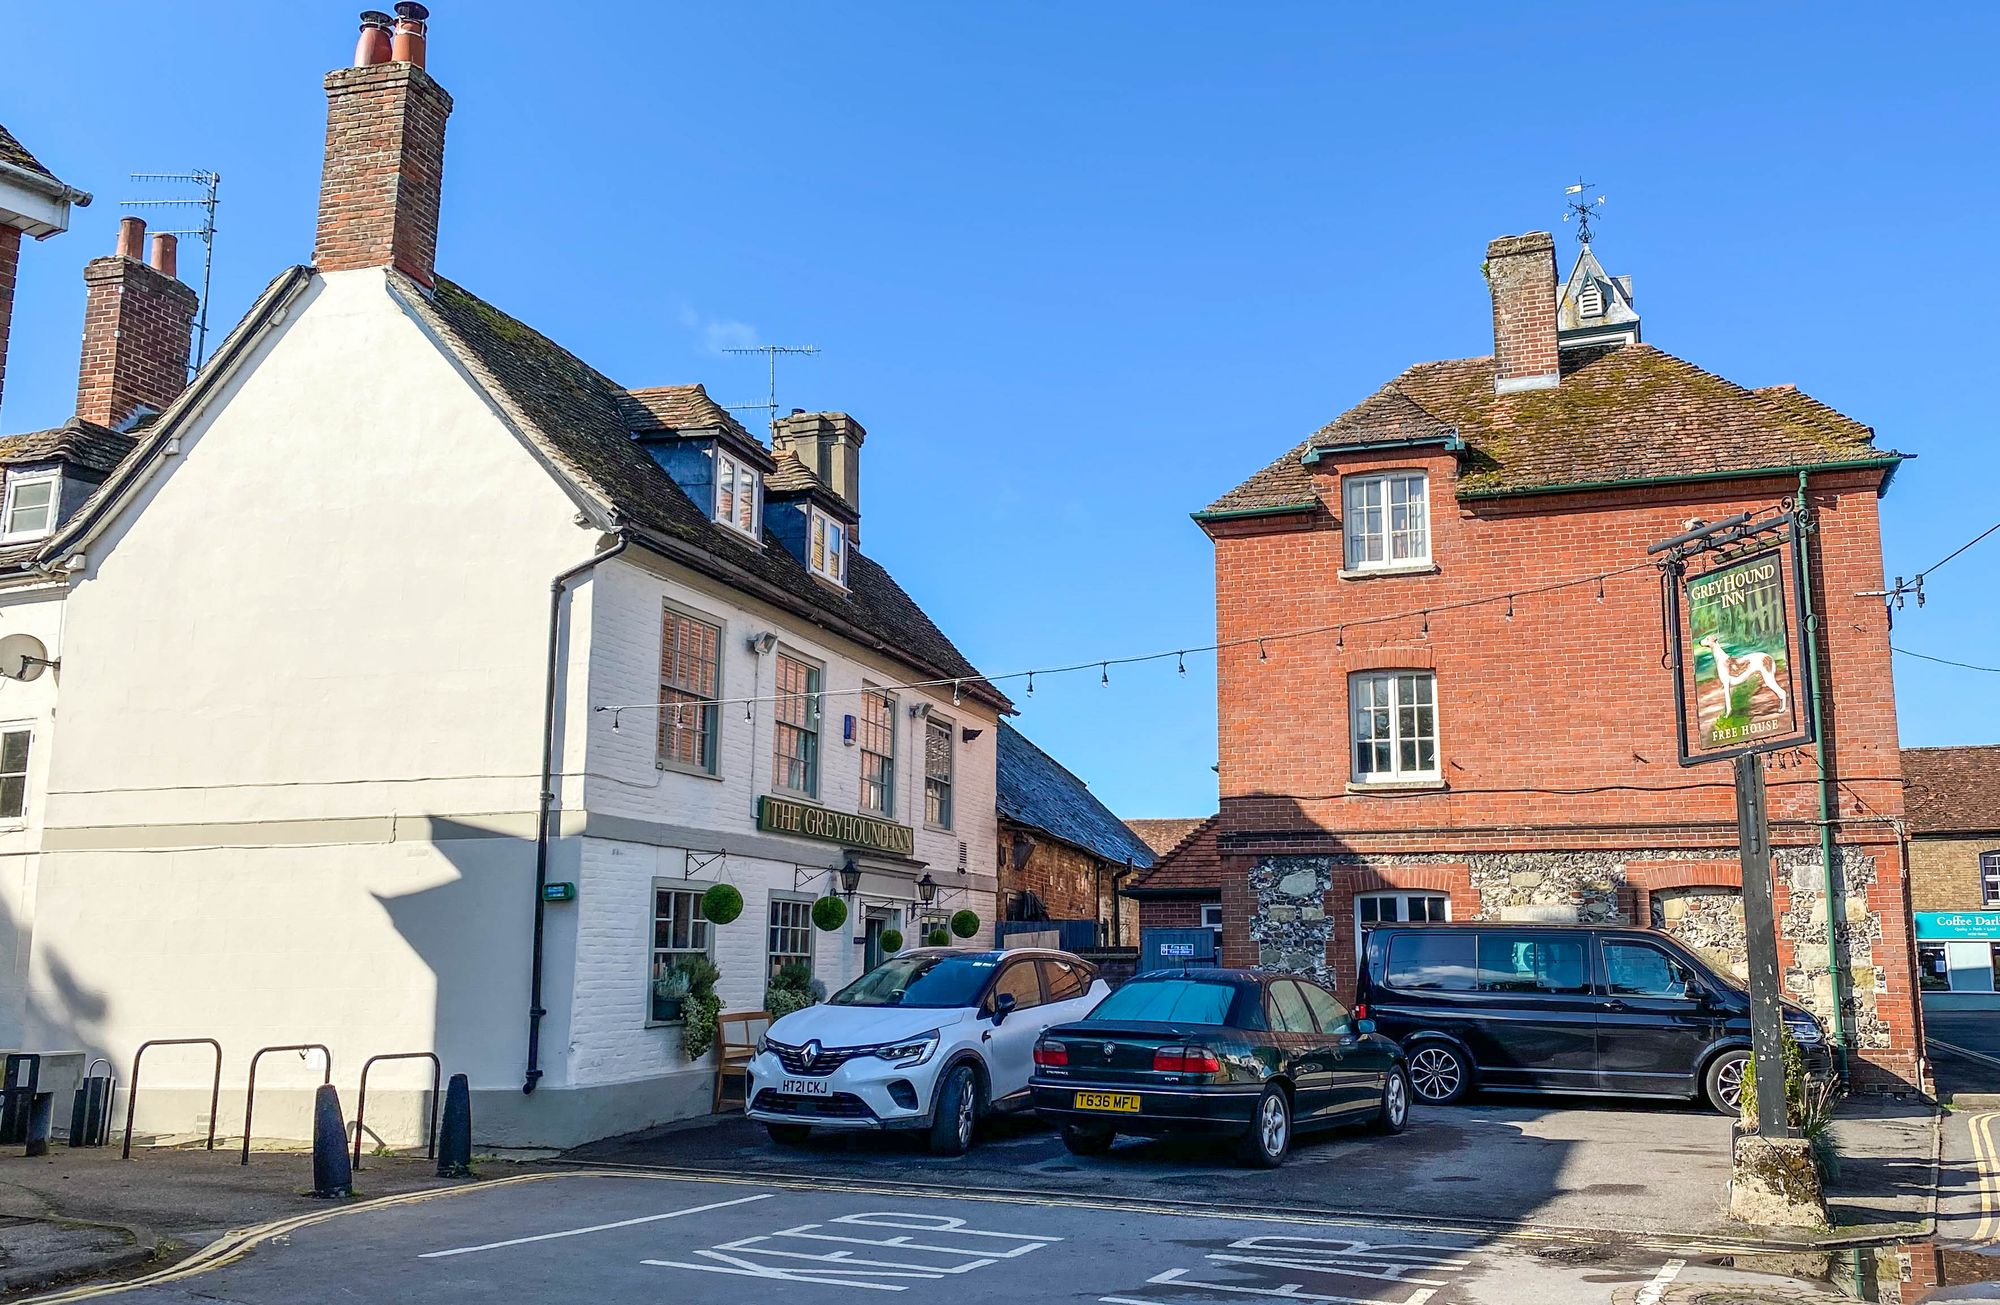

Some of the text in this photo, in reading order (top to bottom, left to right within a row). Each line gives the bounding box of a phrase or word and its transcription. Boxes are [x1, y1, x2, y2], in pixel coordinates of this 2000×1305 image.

[1691, 564, 1775, 601] GREYHOUND
[1721, 590, 1746, 609] INN
[1711, 719, 1779, 742] FREE HOUSE
[771, 801, 912, 850] THE GREYHOUND INN
[1937, 916, 2000, 926] Coffee Darl
[783, 1080, 827, 1093] HT21 CKJ
[1078, 1093, 1138, 1110] T636 MFL
[639, 1211, 1064, 1292] KEEP
